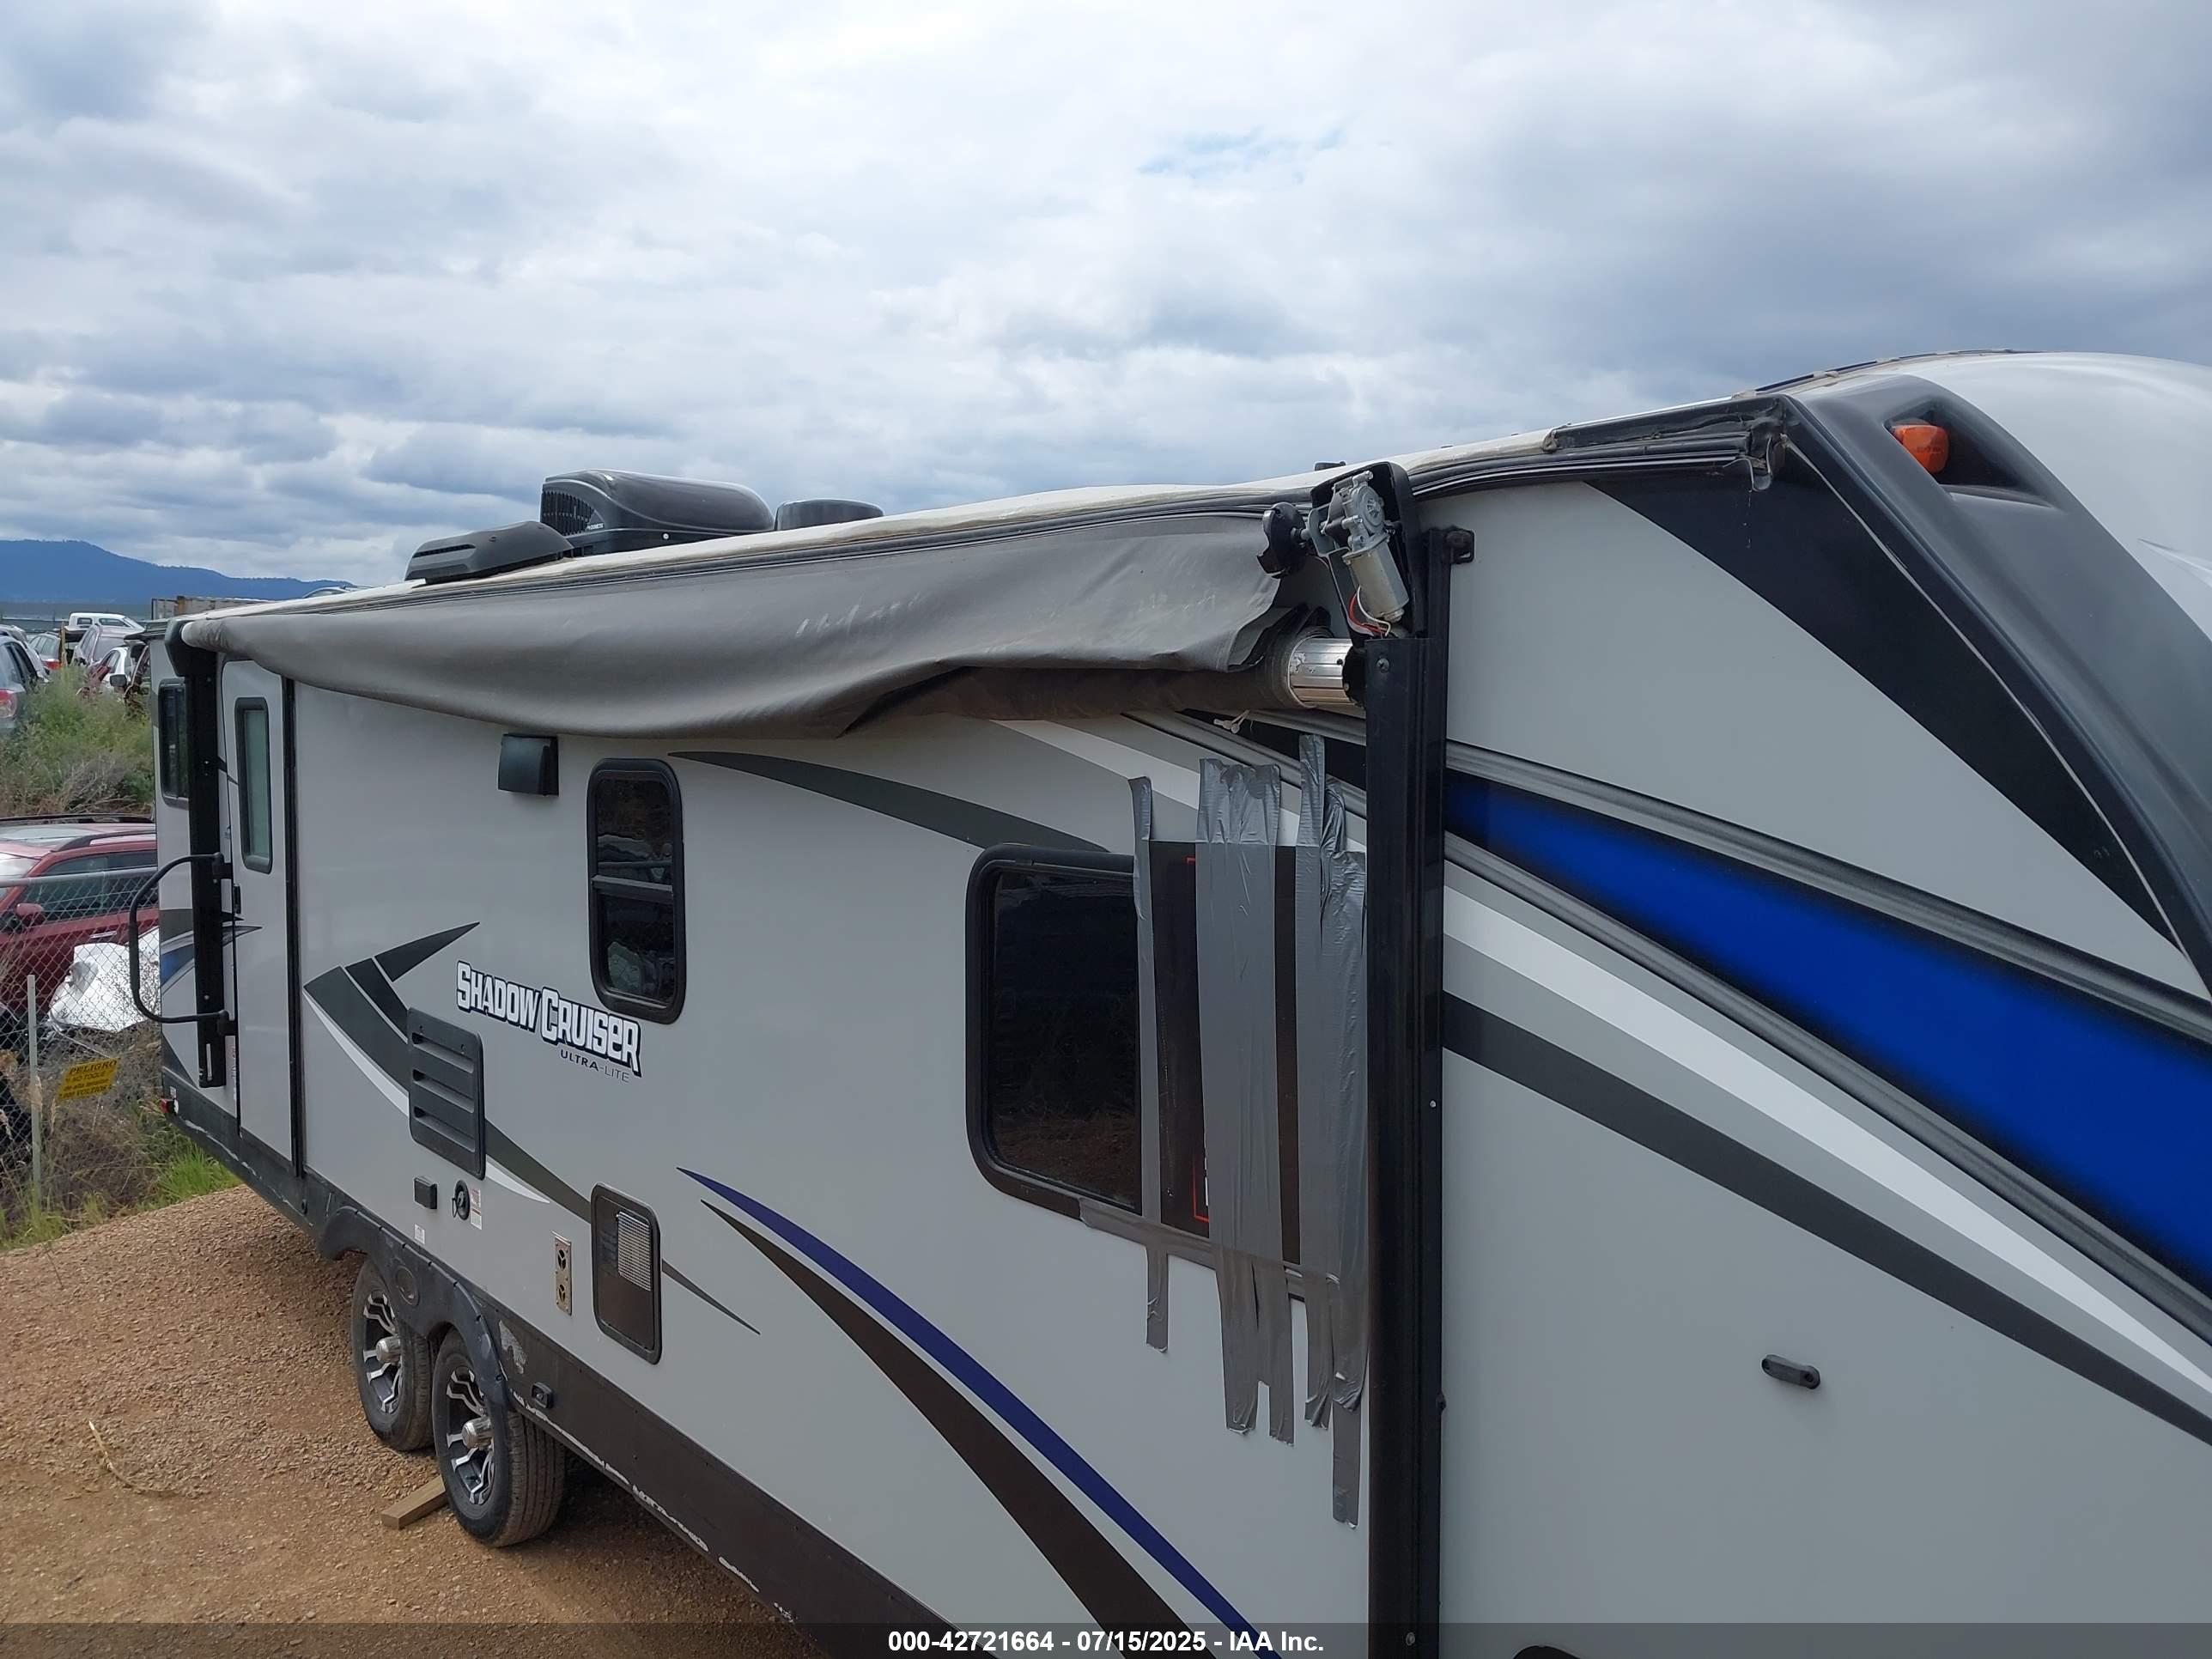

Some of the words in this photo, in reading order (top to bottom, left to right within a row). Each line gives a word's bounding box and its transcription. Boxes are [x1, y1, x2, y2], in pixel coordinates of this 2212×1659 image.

[457, 960, 541, 1033] SHADOW
[69, 1060, 118, 1075] PELIGRO
[560, 1048, 630, 1083] ULTRA-LITE
